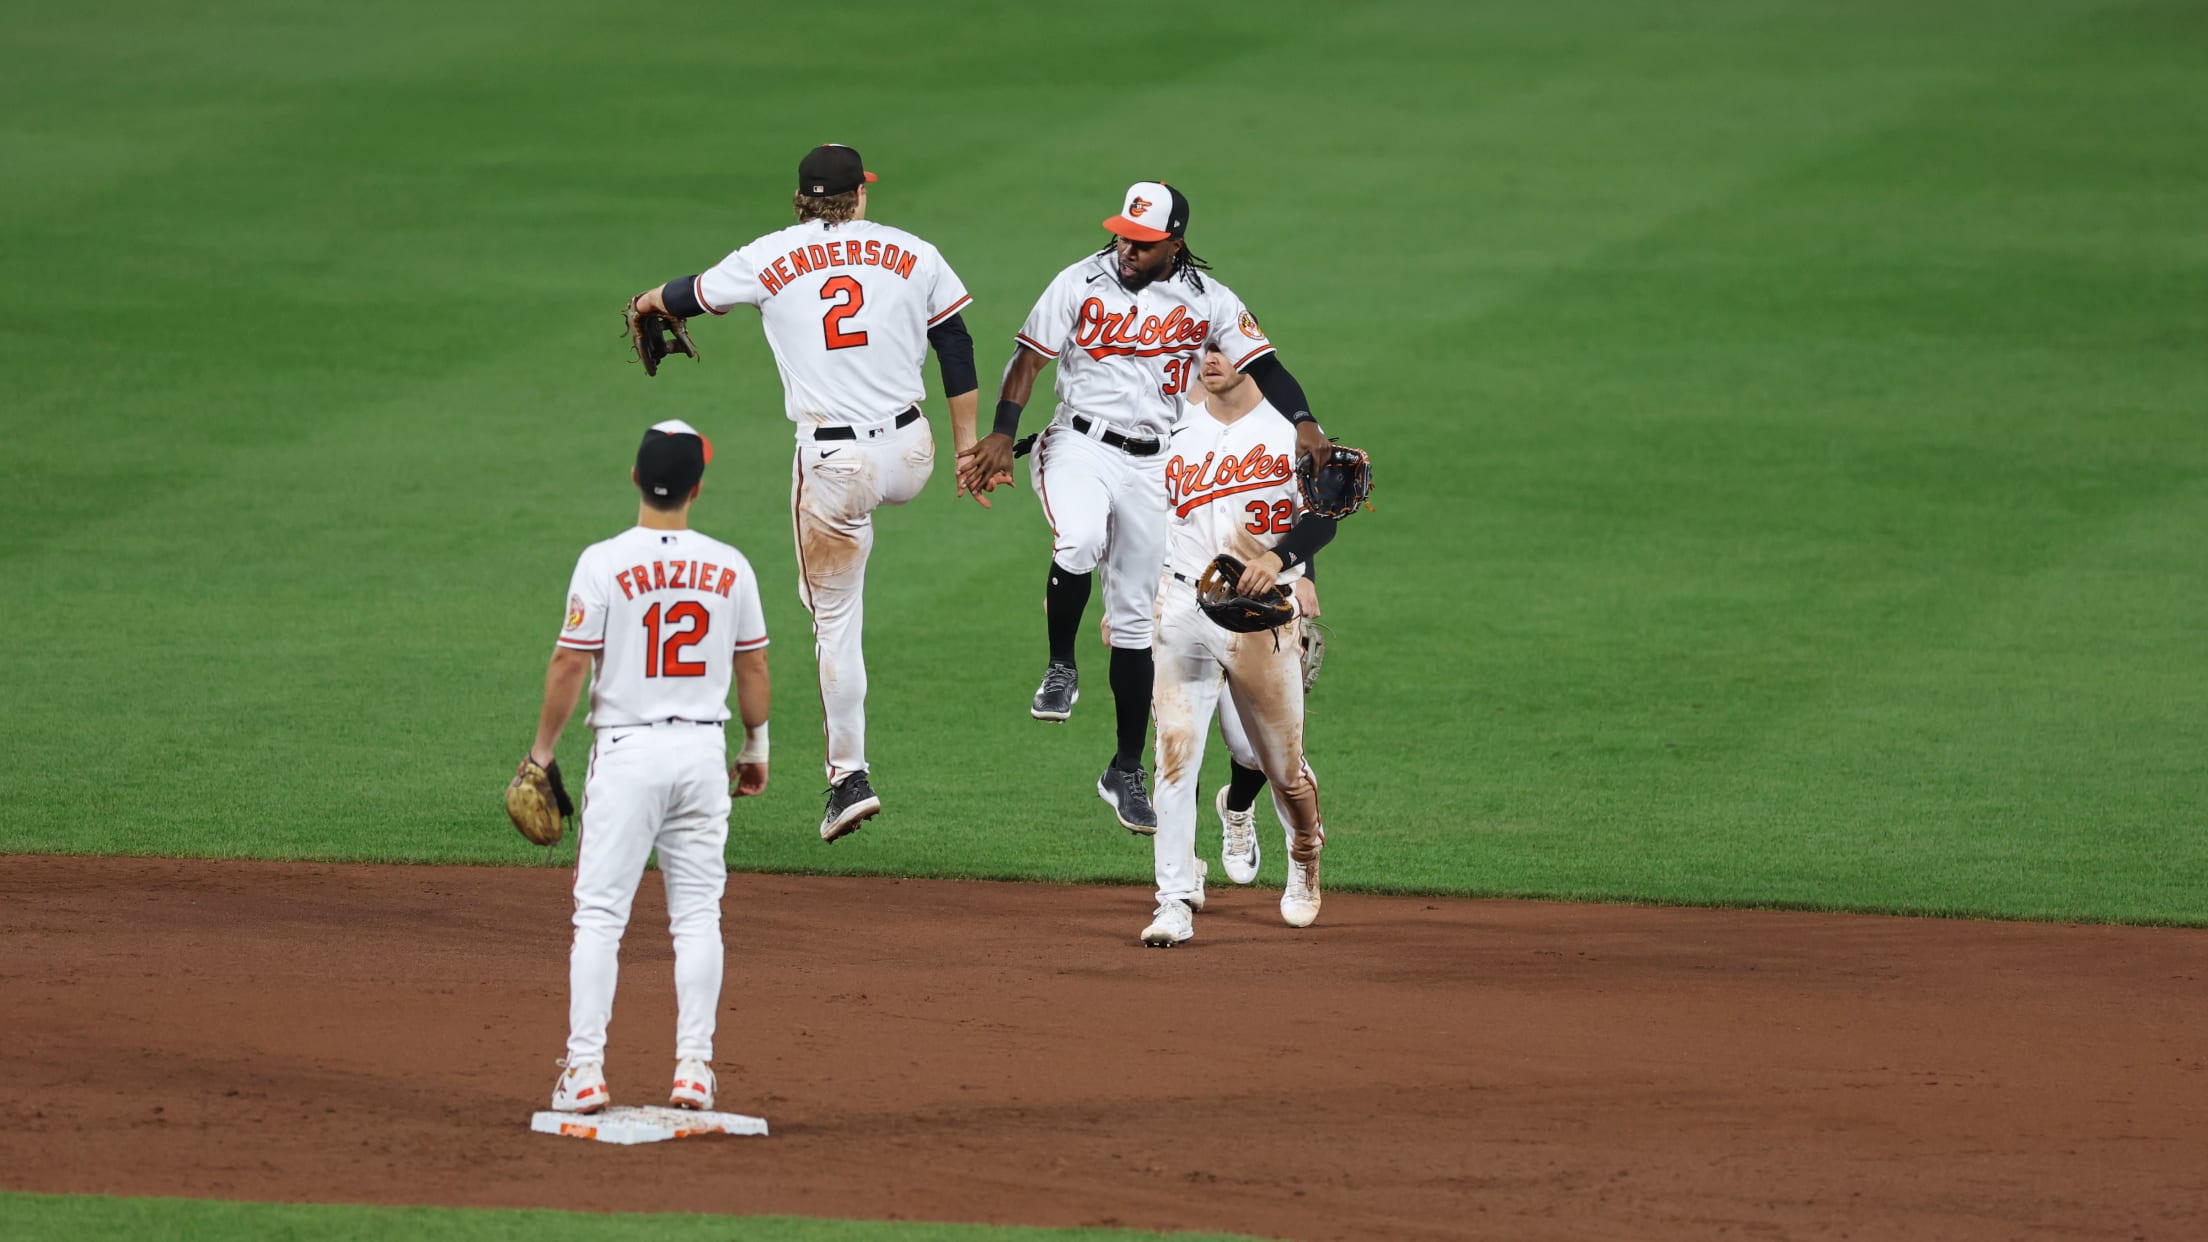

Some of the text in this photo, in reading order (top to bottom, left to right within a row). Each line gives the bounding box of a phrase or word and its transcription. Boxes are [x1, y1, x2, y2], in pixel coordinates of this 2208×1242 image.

[760, 240, 917, 296] HENDERSON
[820, 275, 868, 350] 2
[1076, 297, 1209, 347] Orioles
[1162, 357, 1192, 395] 31
[1245, 499, 1293, 535] 32
[616, 560, 736, 600] FRAZIER
[643, 601, 710, 677] 12
